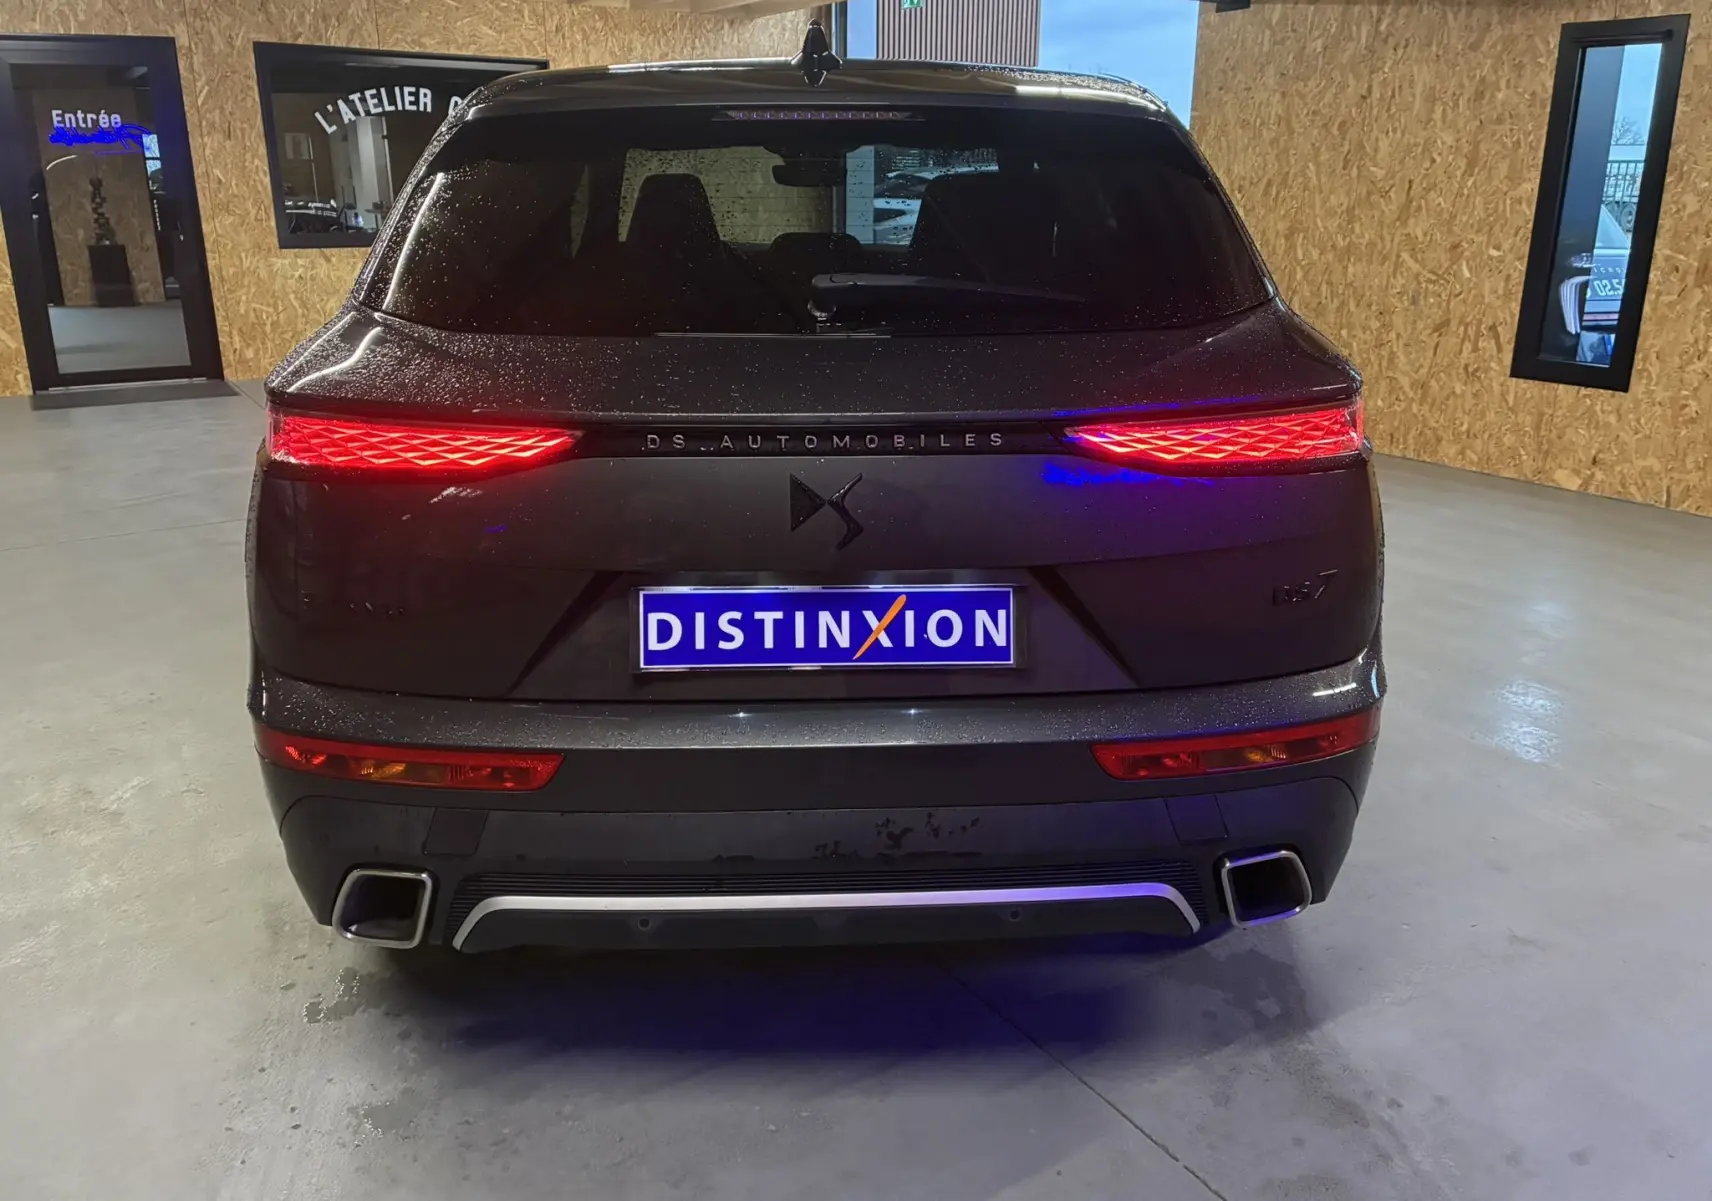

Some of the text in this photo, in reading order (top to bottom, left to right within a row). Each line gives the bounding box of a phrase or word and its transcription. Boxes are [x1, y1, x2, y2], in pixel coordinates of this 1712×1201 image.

[51, 109, 122, 128] Entrée
[314, 86, 432, 134] L'ATELIER
[646, 433, 1004, 450] DS AUTOMOBILES
[646, 597, 1008, 658] DISTINXION
